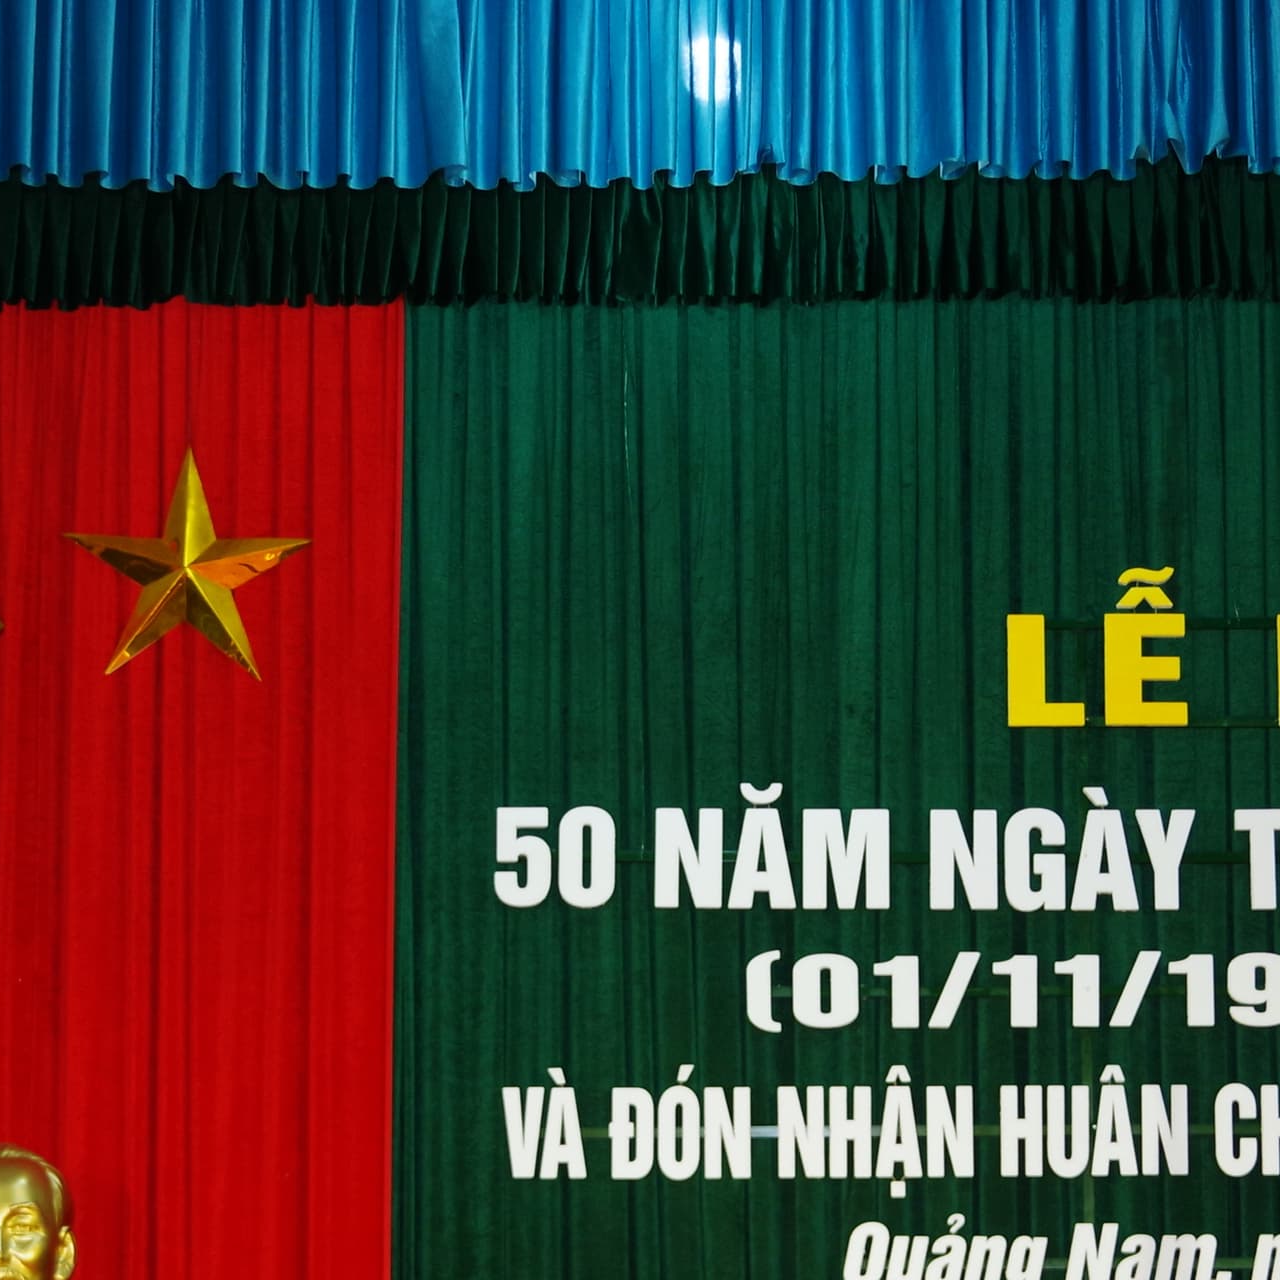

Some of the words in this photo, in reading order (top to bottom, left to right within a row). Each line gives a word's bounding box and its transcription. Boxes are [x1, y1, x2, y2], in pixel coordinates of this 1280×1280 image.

[1007, 567, 1188, 727] LỄ
[494, 806, 615, 908] 50
[655, 783, 890, 909] NĂM
[930, 787, 1195, 911] NGÀY
[503, 1067, 587, 1180] VÀ
[609, 1064, 752, 1180] ĐÓN
[777, 1065, 975, 1198] NHẬN
[1000, 1064, 1189, 1178] HUÂN
